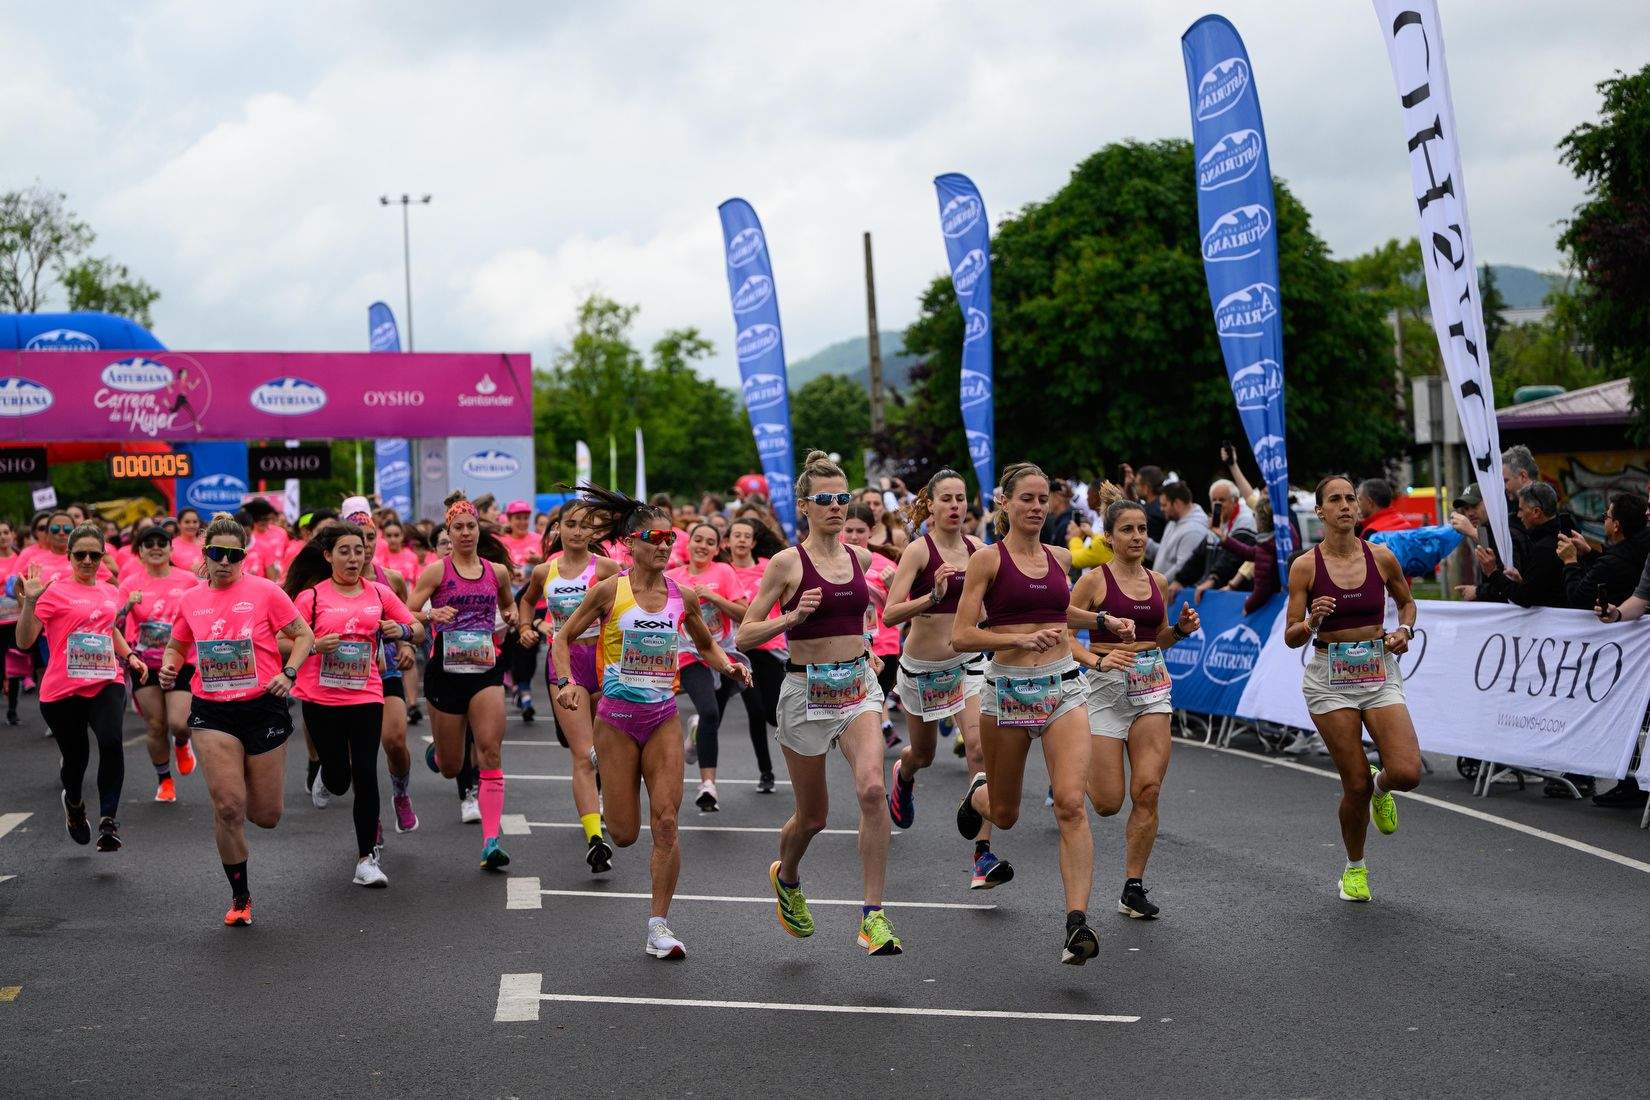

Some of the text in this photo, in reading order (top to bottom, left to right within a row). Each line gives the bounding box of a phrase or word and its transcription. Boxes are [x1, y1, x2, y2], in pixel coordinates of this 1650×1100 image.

[257, 389, 321, 406] ASTURIANA
[363, 390, 425, 407] OYSHO
[457, 393, 514, 408] Santander
[259, 455, 321, 472] OYSHO
[1474, 633, 1623, 703] OYSHO
[1497, 713, 1567, 733] WWW.OYSHO.COM
